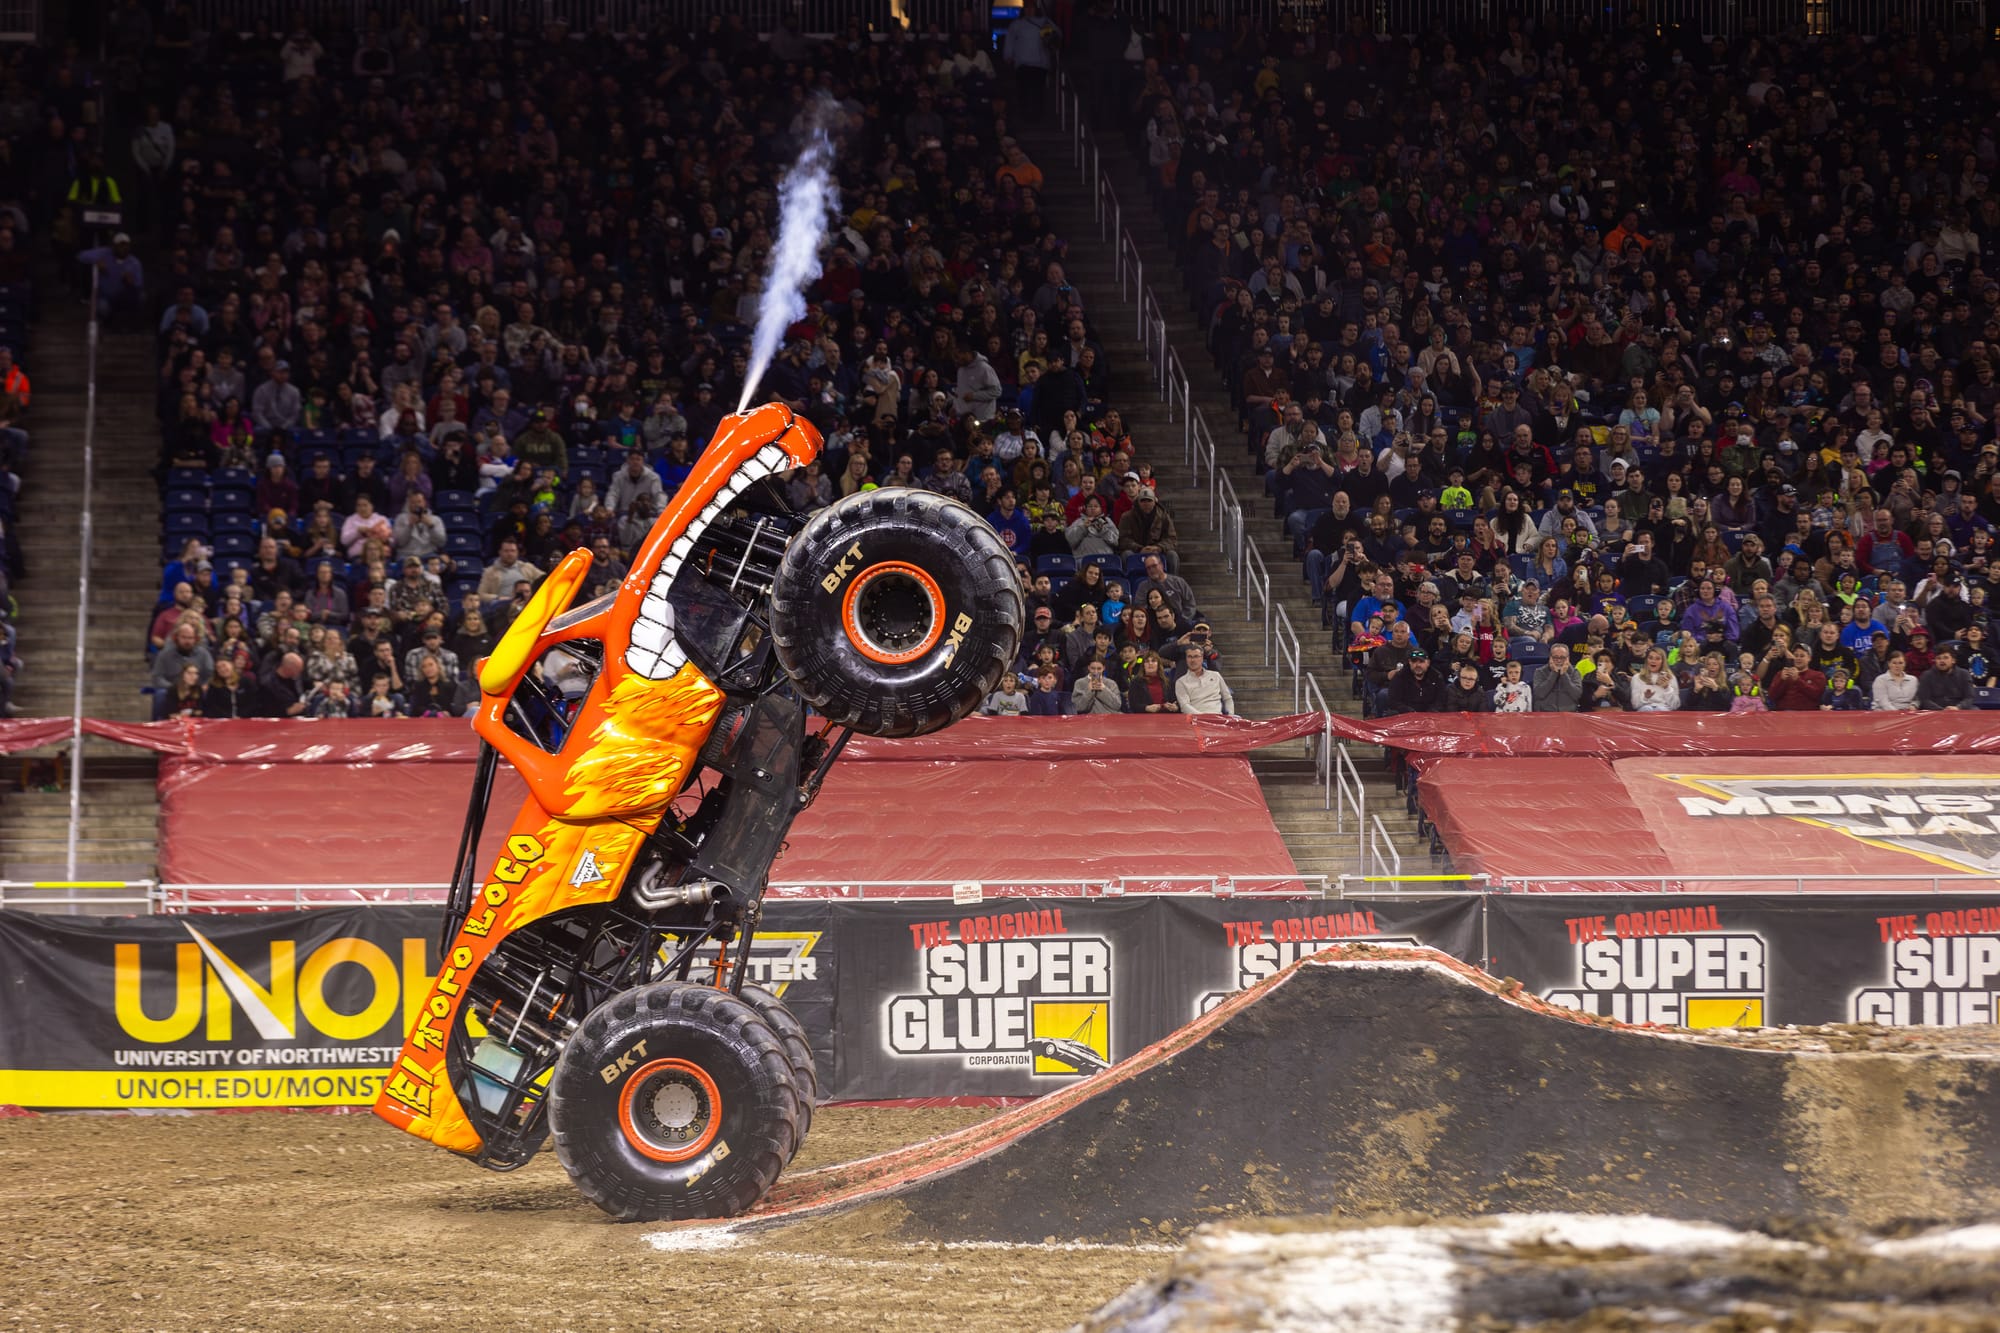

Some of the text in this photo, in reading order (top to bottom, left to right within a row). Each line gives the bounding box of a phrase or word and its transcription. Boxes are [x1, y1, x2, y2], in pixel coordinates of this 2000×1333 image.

[821, 541, 864, 594] BKT
[944, 612, 973, 669] BKT
[1677, 794, 2000, 816] MONS
[1849, 814, 2000, 837] JA
[909, 908, 1068, 950] THE ORIGINAL
[1223, 911, 1381, 947] THE ORIGINAL
[1565, 905, 1723, 945] THE ORIGINAL
[1876, 915, 1918, 943] THE
[930, 941, 1108, 995] SUPER
[1585, 938, 1763, 990] SUPER
[891, 997, 1026, 1051] GLUE
[114, 1049, 235, 1066] UNIVERSITY
[236, 1049, 264, 1065] OF
[600, 1039, 648, 1085] BKT
[969, 1055, 1030, 1065] CORPORATION
[686, 1140, 731, 1188] BKT
